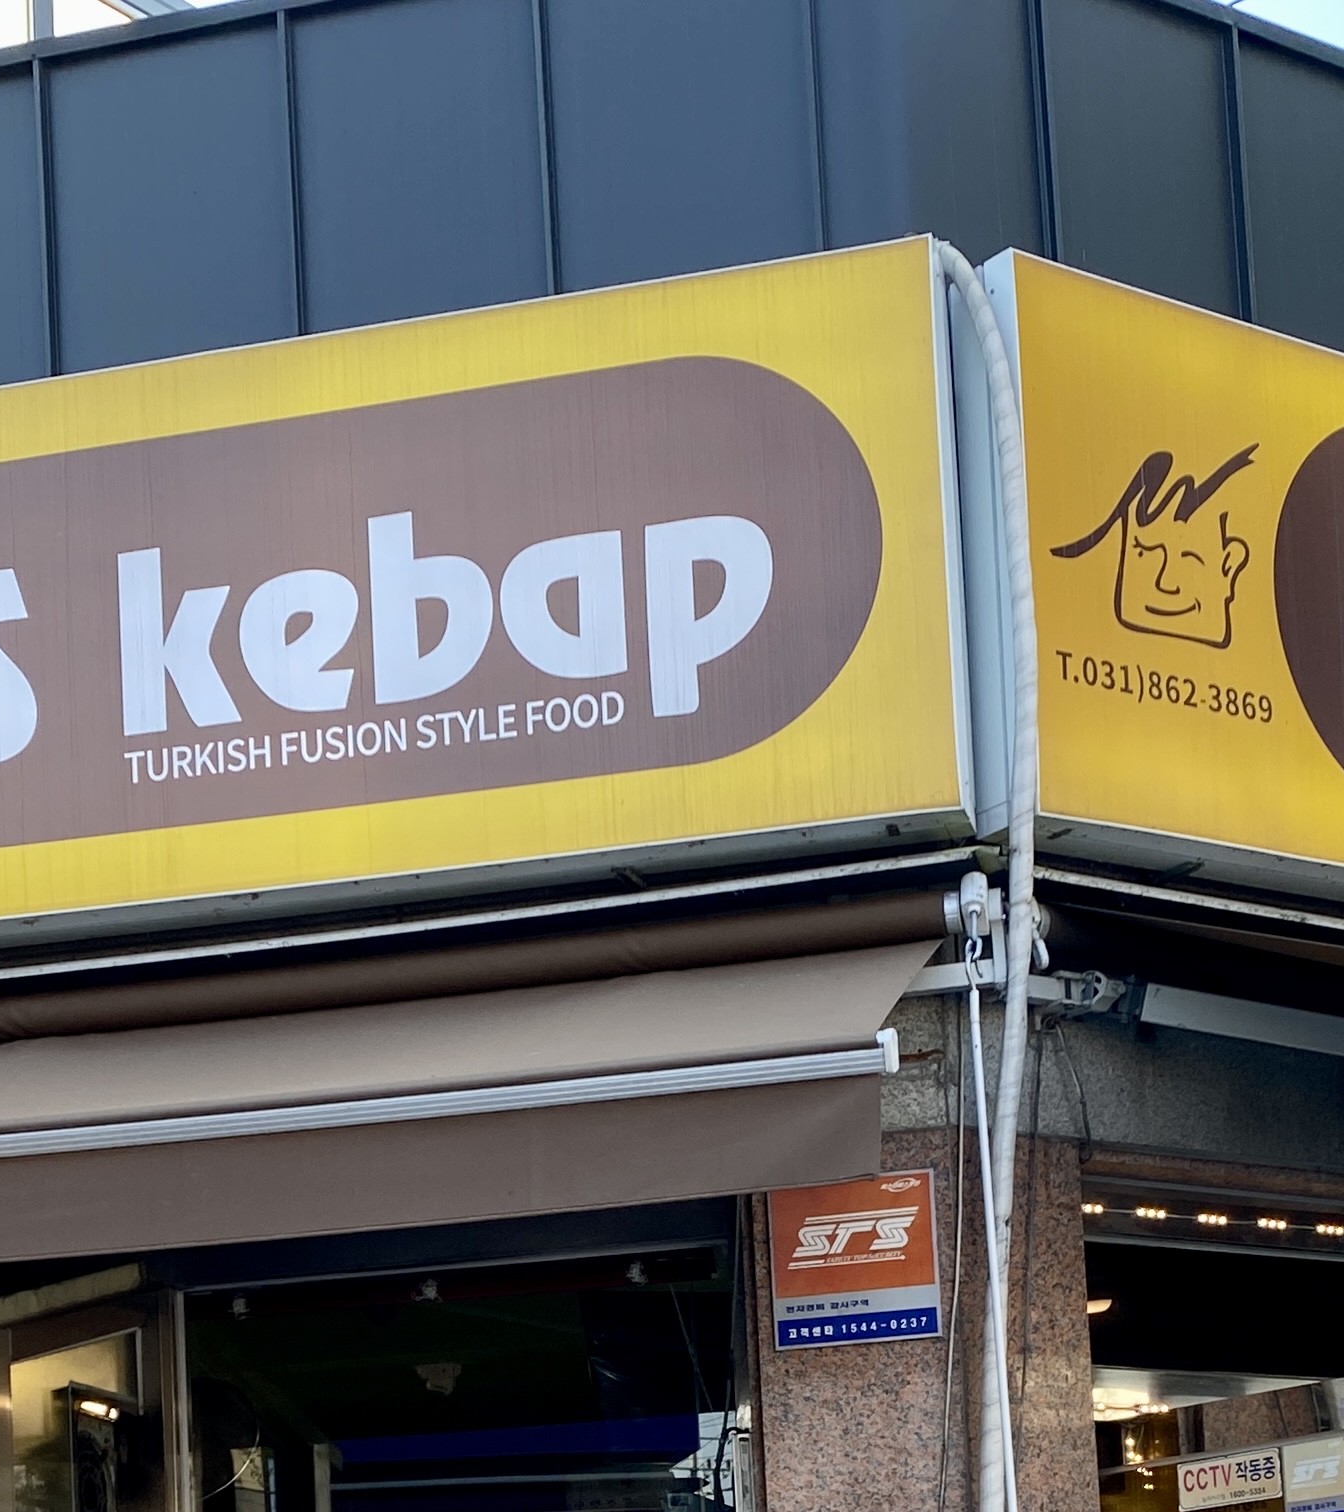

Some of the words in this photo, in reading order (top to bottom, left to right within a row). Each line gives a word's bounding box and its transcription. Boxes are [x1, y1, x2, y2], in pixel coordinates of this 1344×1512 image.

[117, 510, 773, 736] kebap
[1056, 649, 1274, 725] T.031)862-3869
[124, 735, 271, 784] TURKISH
[280, 719, 408, 767] FUSION
[415, 703, 517, 751] STYLE
[525, 690, 625, 737] FOOD
[792, 1215, 916, 1258] STS
[841, 1316, 927, 1334] 1544-0237
[1183, 1463, 1232, 1492] CCTV
[1235, 1456, 1276, 1483] 작동중
